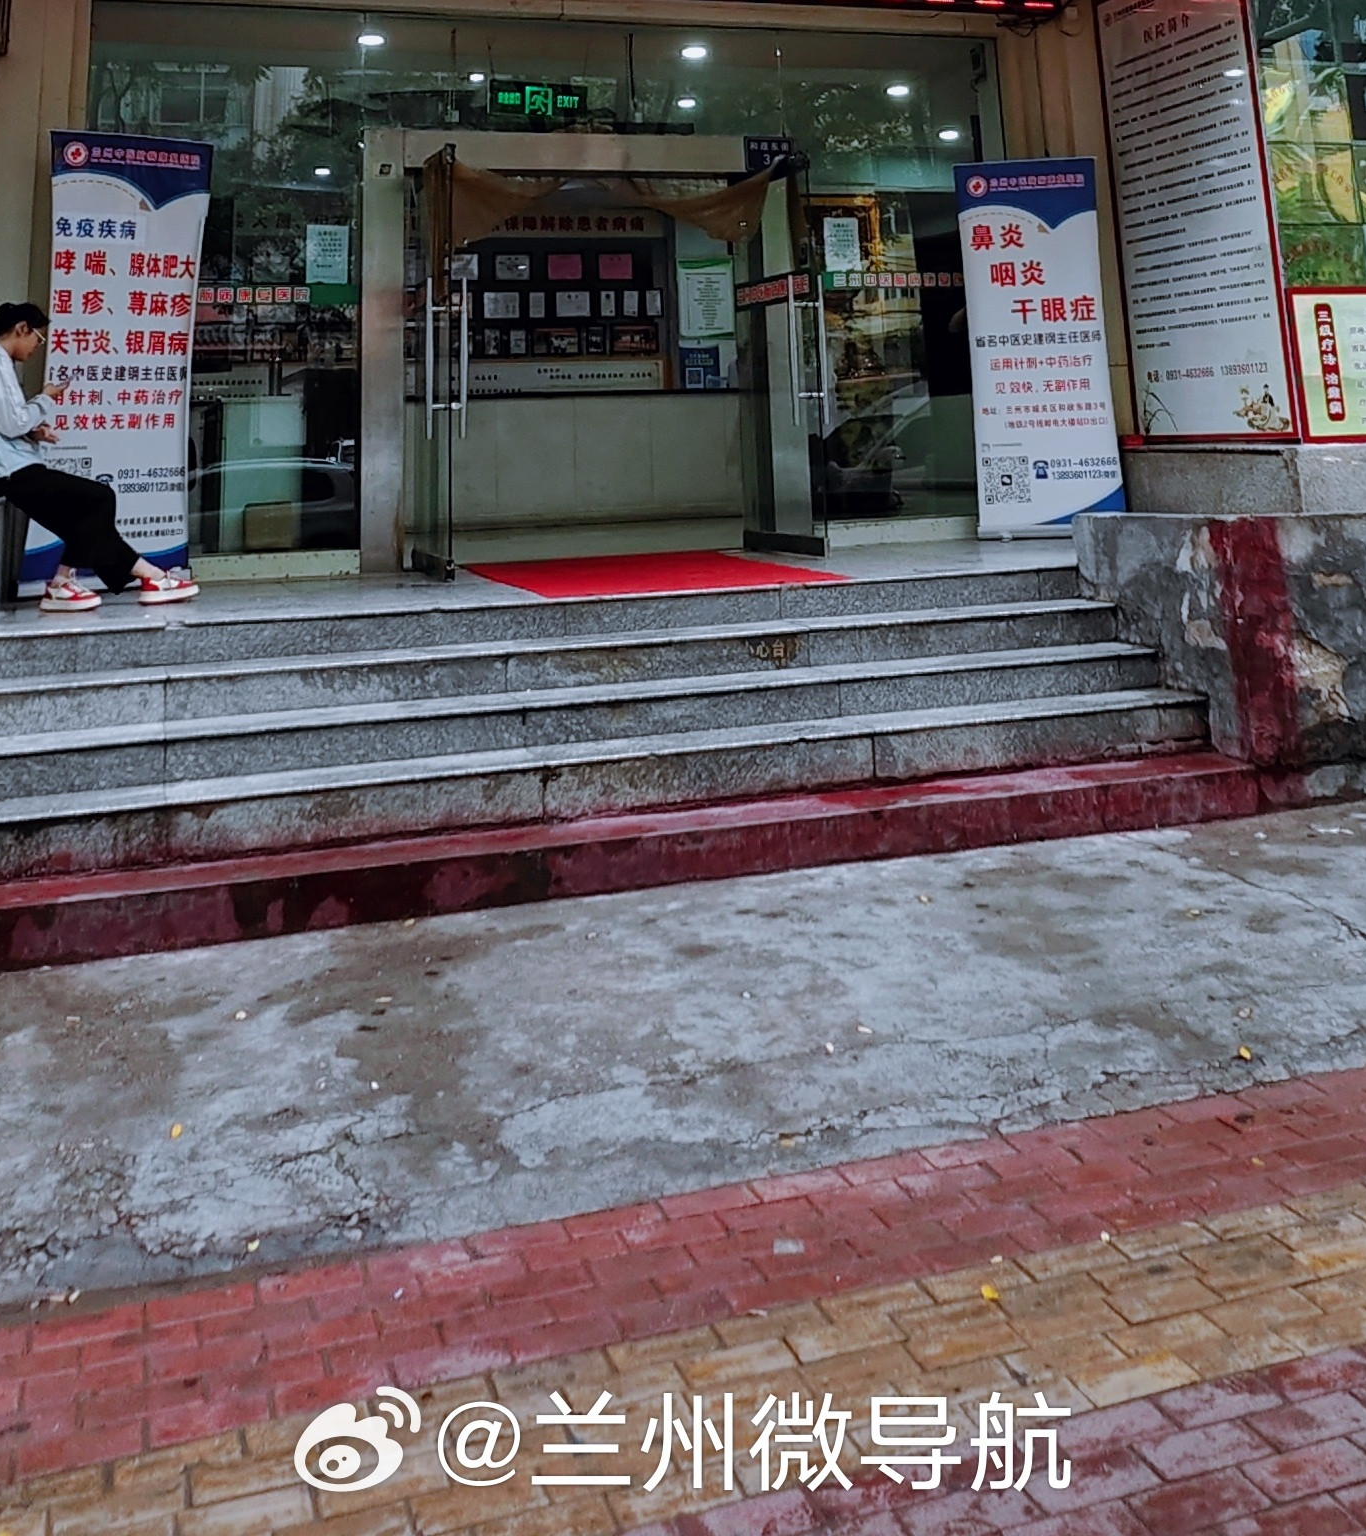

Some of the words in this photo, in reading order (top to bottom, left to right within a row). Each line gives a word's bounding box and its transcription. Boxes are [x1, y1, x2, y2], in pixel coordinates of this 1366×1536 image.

[557, 95, 579, 109] EXIT
[55, 216, 136, 240] 免疫疾病
[492, 215, 645, 232] 保障解除患者病痛
[970, 223, 1024, 250] 鼻炎
[990, 260, 1045, 287] 咽炎
[1011, 295, 1097, 324] 干眼症
[53, 413, 175, 431] 见效快无副作用
